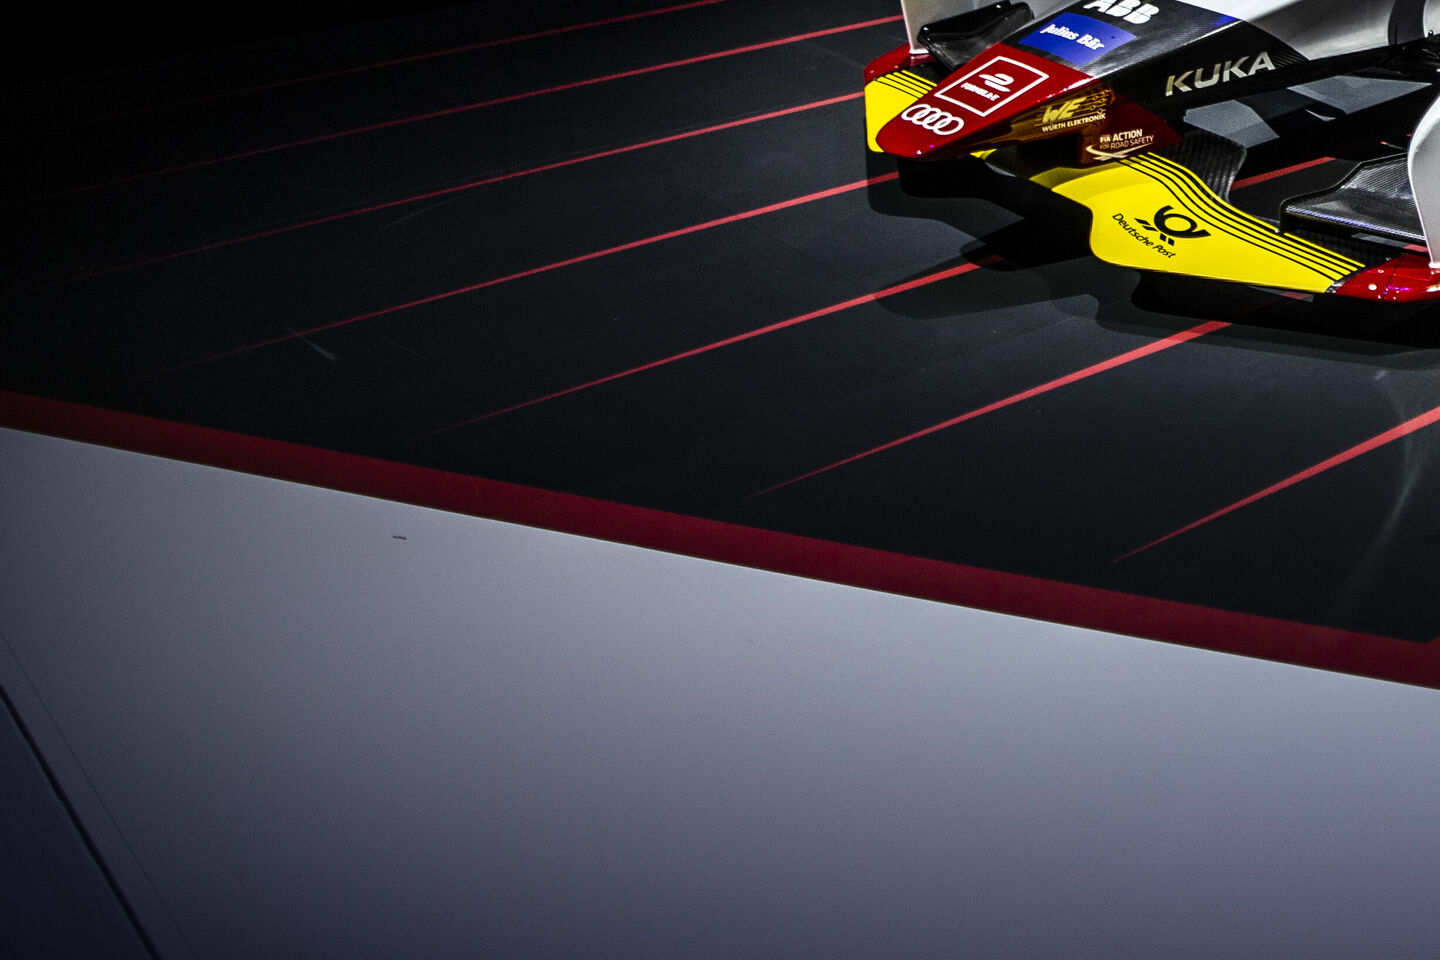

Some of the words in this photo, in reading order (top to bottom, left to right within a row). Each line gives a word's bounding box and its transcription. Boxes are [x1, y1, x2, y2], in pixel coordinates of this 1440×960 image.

[1040, 23, 1080, 40] Julius
[1164, 50, 1277, 98] KUKA
[1042, 96, 1087, 124] WE
[1041, 122, 1066, 133] WÜRTH
[1067, 112, 1107, 128] ELEKTRONIK
[1110, 140, 1130, 150] ROAD
[1129, 135, 1154, 146] SAFETY
[1112, 128, 1143, 142] ACTION
[1112, 213, 1154, 246] Deutsche
[1152, 244, 1177, 259] Post
